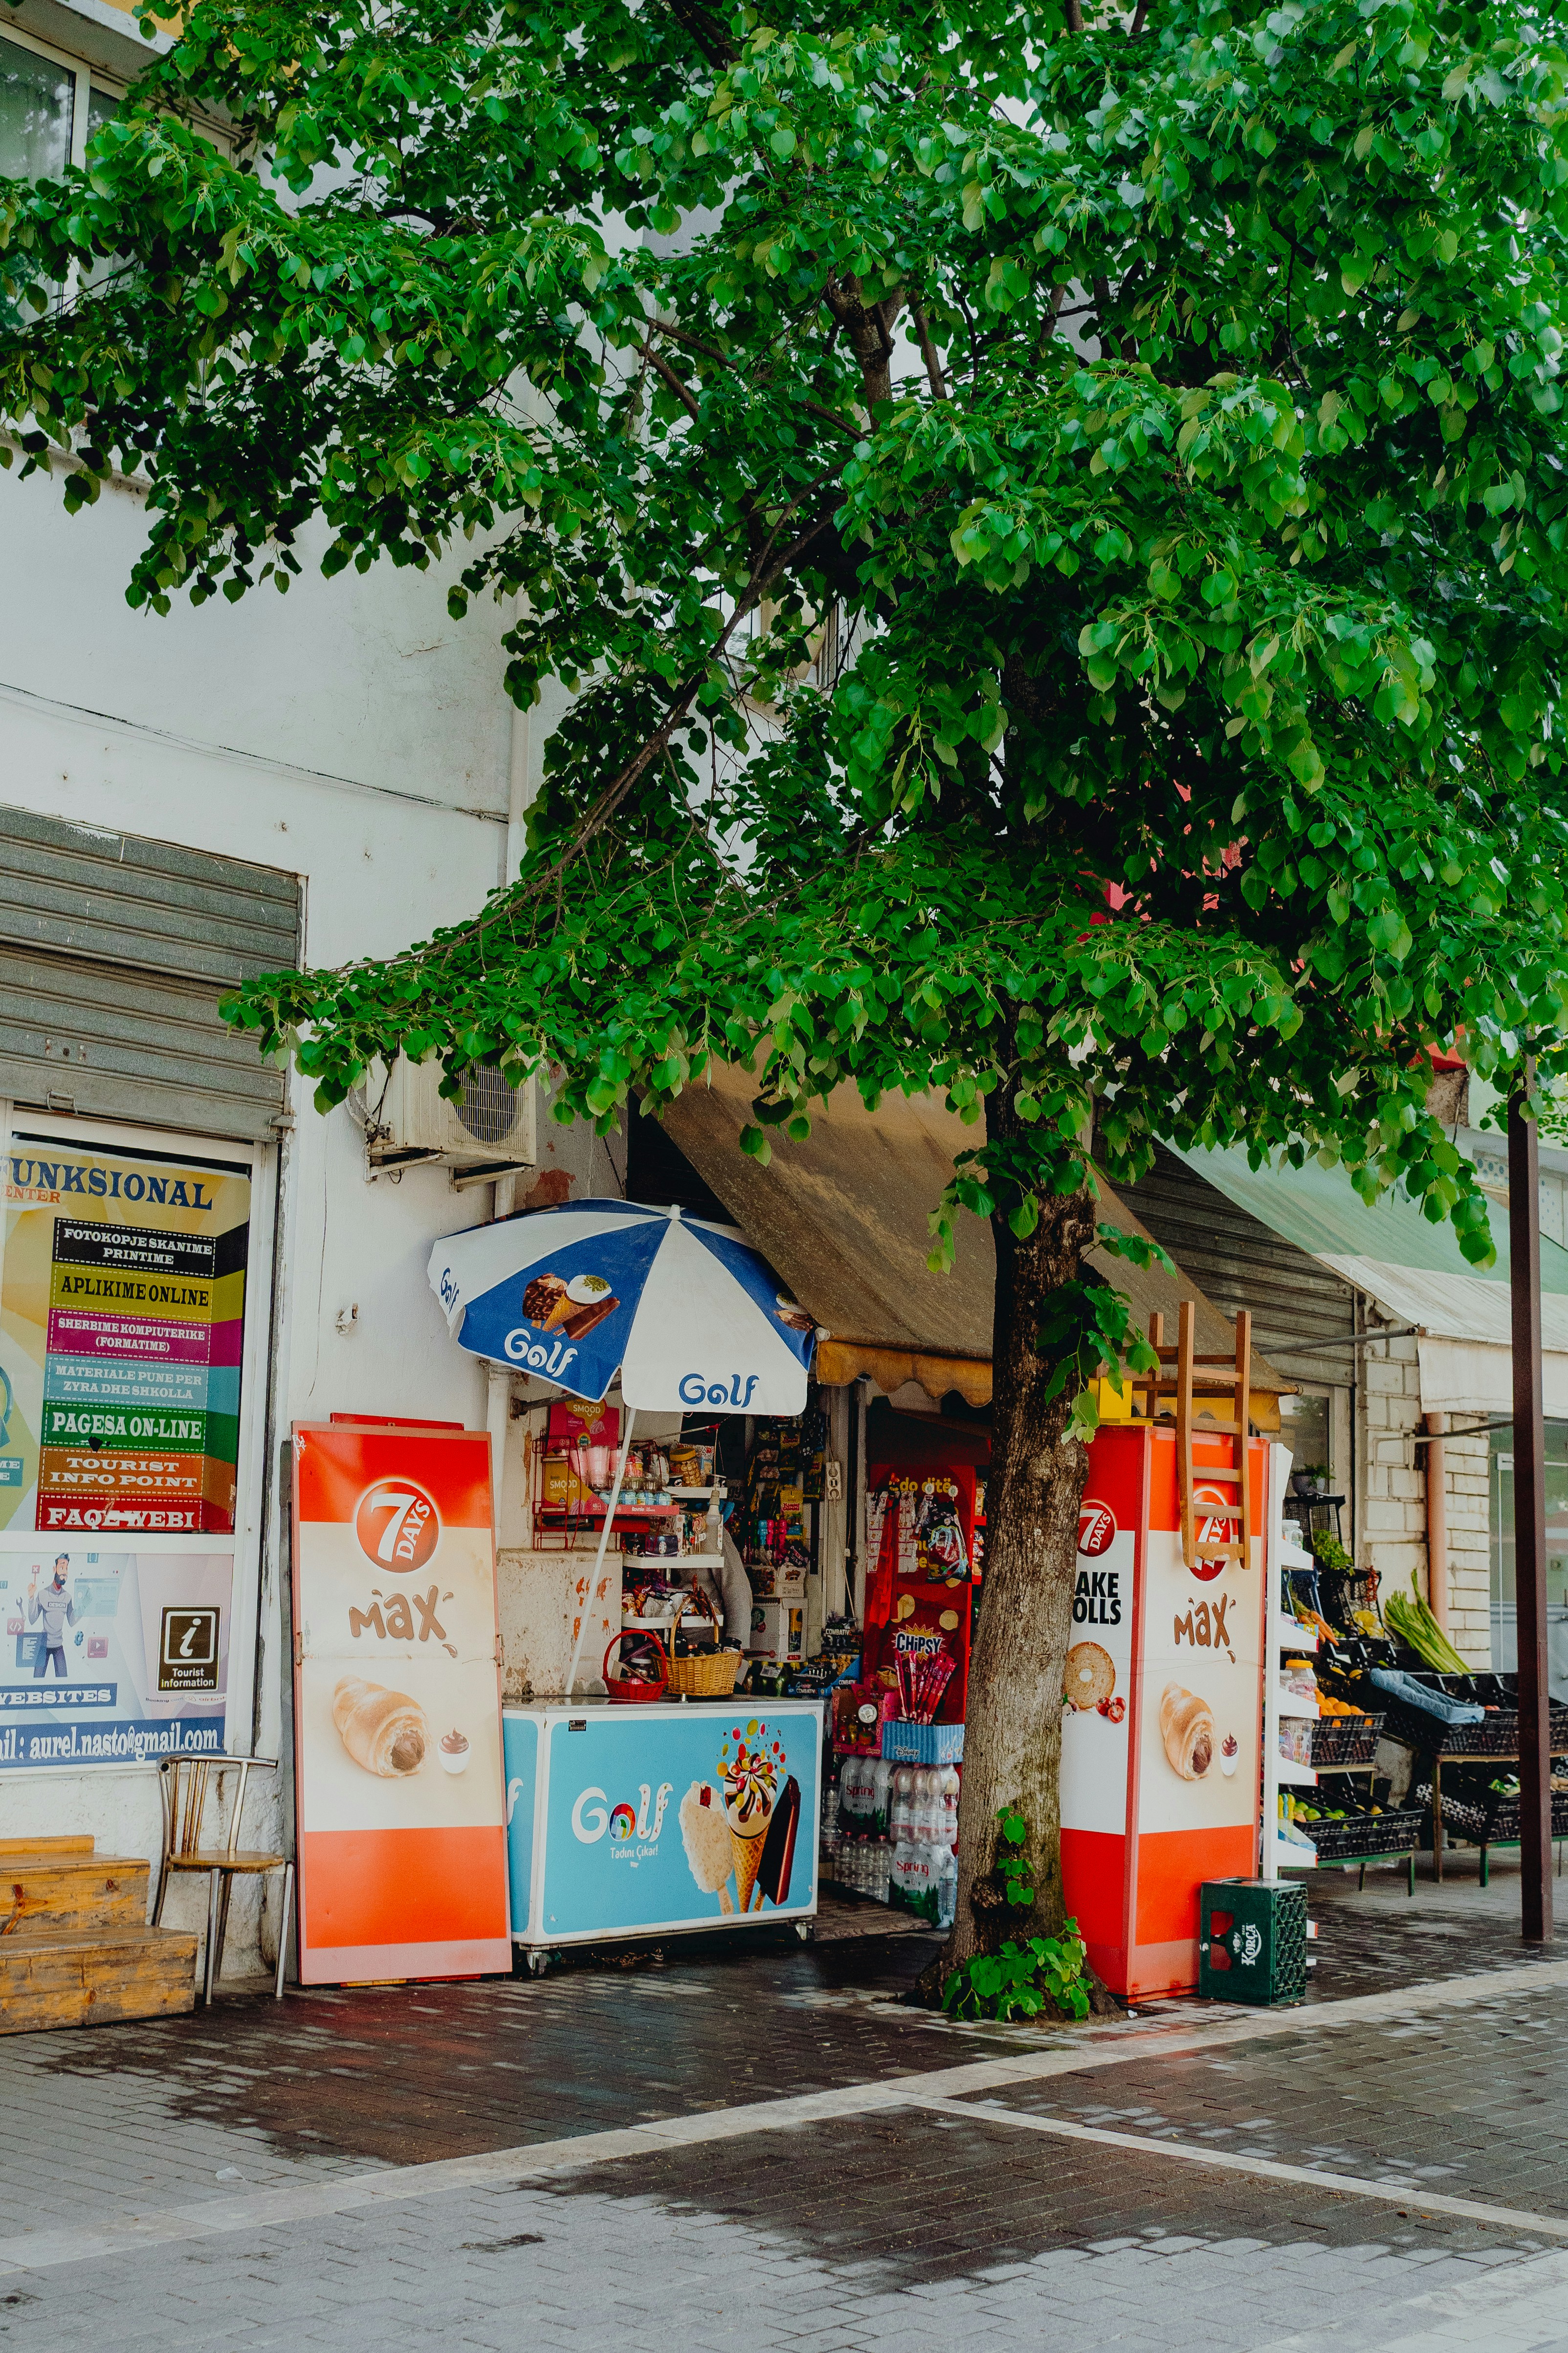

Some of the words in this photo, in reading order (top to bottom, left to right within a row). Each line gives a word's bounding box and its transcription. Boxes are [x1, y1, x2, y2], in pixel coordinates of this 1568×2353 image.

[1, 1184, 60, 1203] ENTER
[64, 1228, 147, 1247] FOTOKOPJE
[149, 1238, 212, 1255] SKANIME
[103, 1247, 174, 1265] PRINTIME
[61, 1276, 146, 1300] APLIKIME
[149, 1285, 209, 1307] ONLINE
[441, 1267, 460, 1315] Golf
[58, 1318, 119, 1332] SHERBIME
[120, 1324, 205, 1340] KOMPIUTERIKE
[95, 1336, 170, 1353] (FORMATIME)
[504, 1328, 578, 1377] Golf
[55, 1365, 135, 1380] MATERIALE
[137, 1372, 174, 1383] PUNE
[176, 1375, 202, 1385] PER
[63, 1381, 99, 1393] ZYRA
[101, 1383, 130, 1395] DHE
[132, 1385, 193, 1399] SHKOLLA
[679, 1373, 760, 1408] Golf
[51, 1412, 128, 1436] PAGESA
[130, 1417, 202, 1440] ON-LINE
[66, 1458, 179, 1472] TOURIST
[49, 1472, 115, 1485] INFO
[119, 1475, 197, 1487] POINT
[371, 1493, 417, 1562] 7
[396, 1500, 430, 1561] DAYS
[1090, 1512, 1111, 1550] DAYS
[1075, 1571, 1119, 1598] AKE
[1072, 1597, 1122, 1625] OLLS
[173, 1667, 204, 1677] Tourist
[29, 1721, 221, 1762] aurel.nasto@gmail.com
[571, 1782, 674, 1844] Golf
